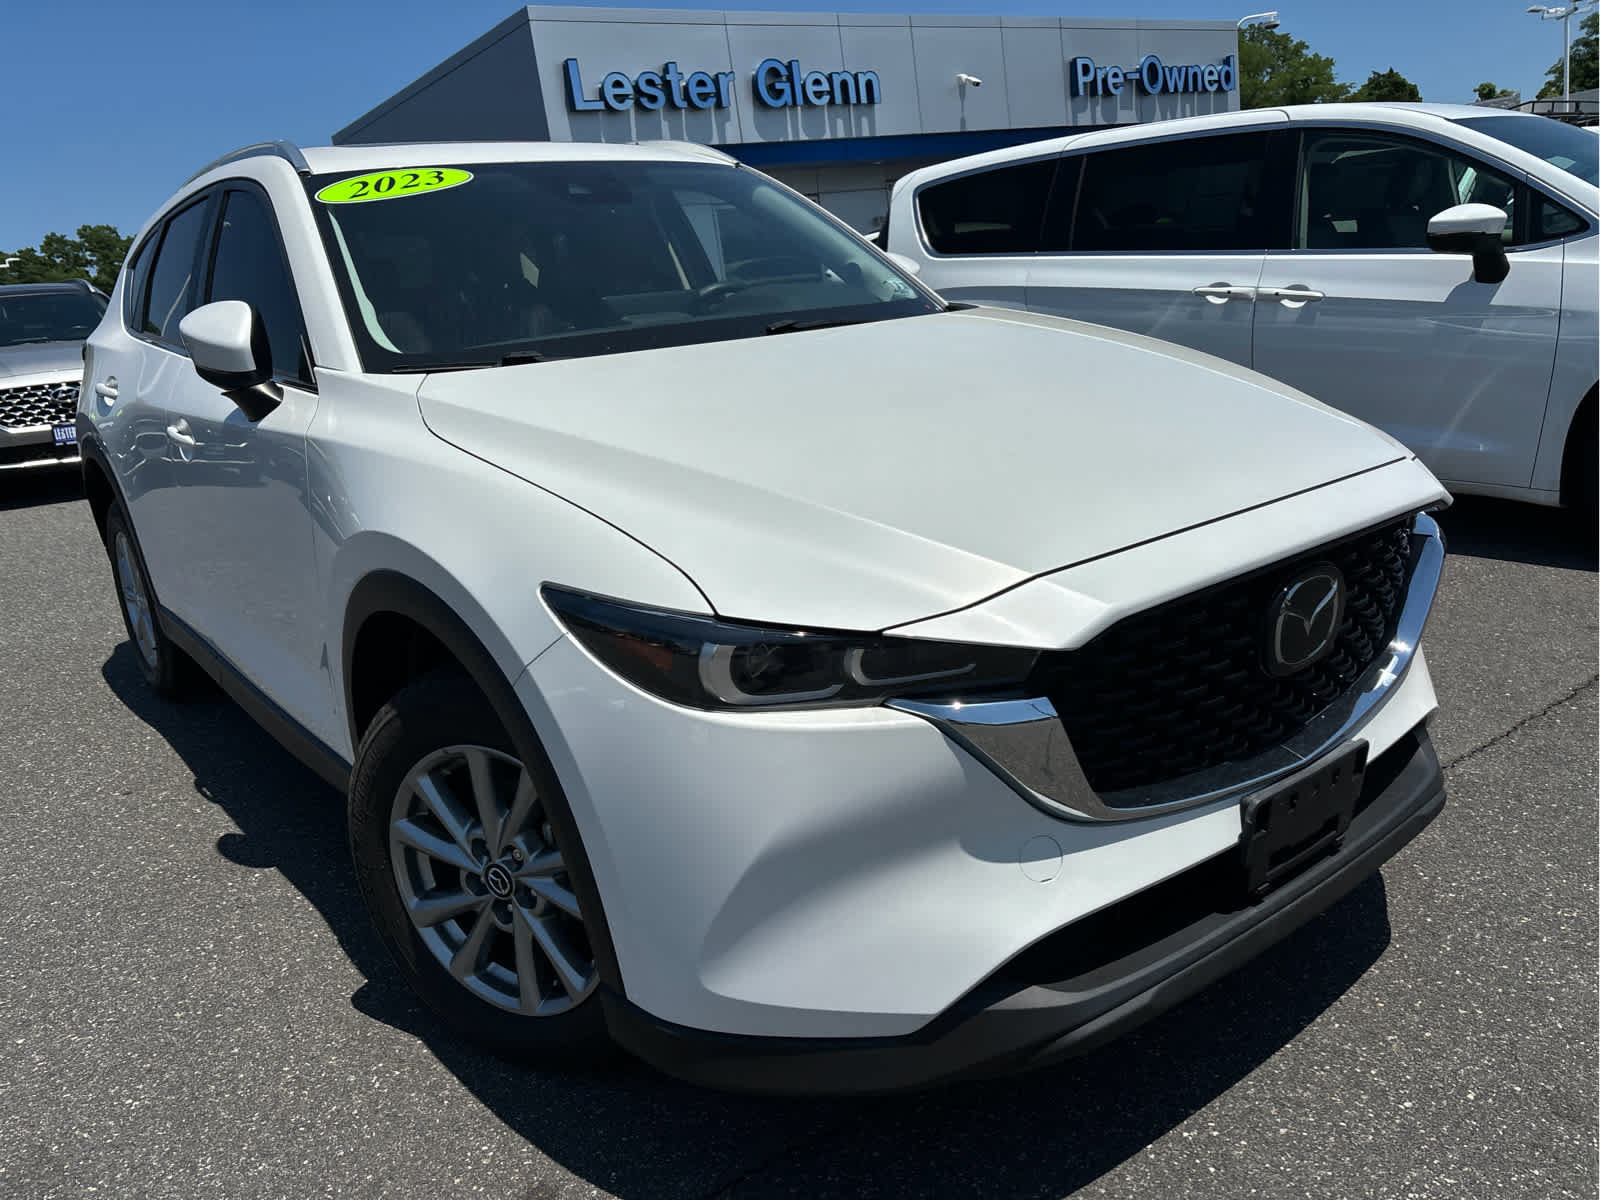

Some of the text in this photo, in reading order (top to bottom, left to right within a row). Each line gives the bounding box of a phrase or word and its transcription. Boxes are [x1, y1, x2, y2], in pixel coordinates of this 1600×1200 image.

[563, 58, 881, 112] Lester Glenn
[1071, 55, 1236, 97] Pre-Owned
[349, 171, 445, 199] 2023
